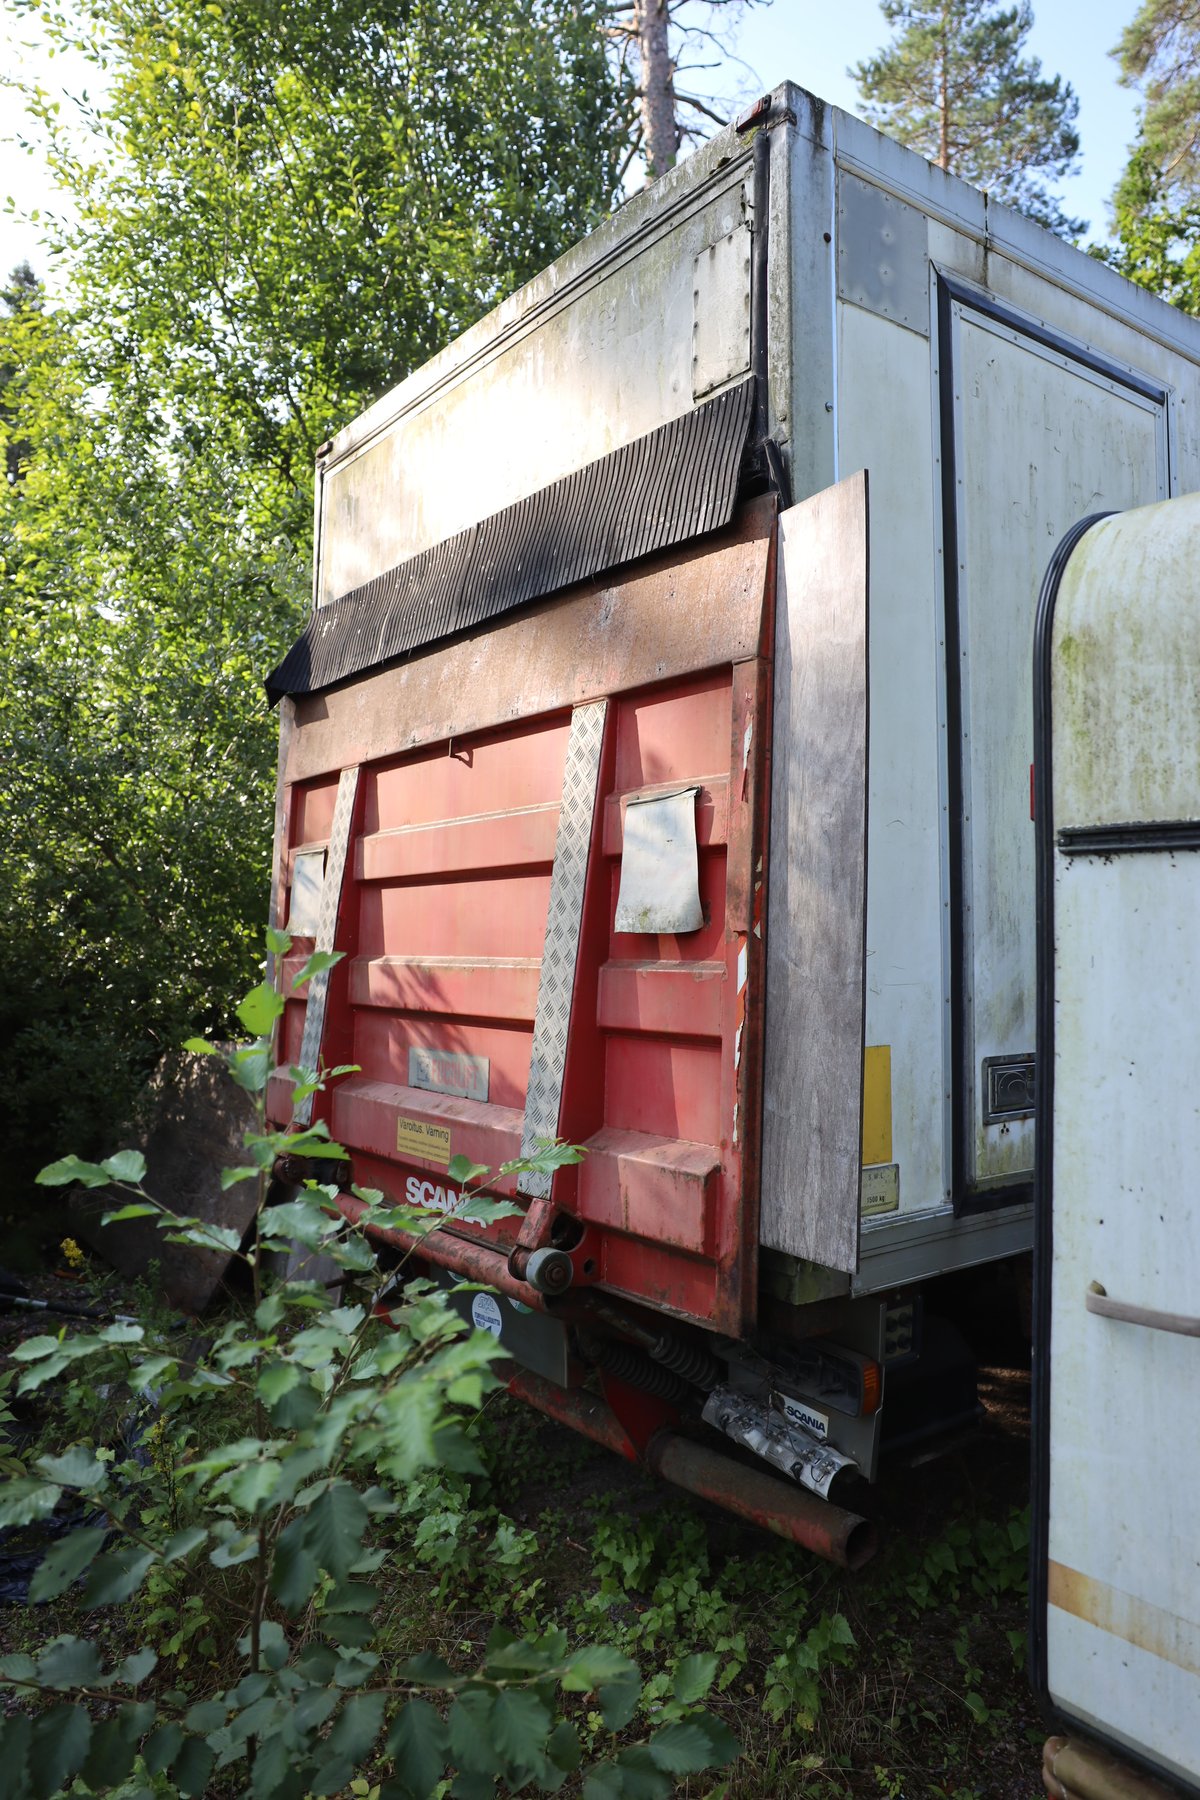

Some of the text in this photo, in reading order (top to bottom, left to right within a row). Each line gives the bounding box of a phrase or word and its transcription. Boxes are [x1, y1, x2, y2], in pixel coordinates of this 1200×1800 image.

[426, 1124, 449, 1143] Varning
[405, 1176, 487, 1229] SCAN
[785, 1405, 826, 1433] SCANIA
